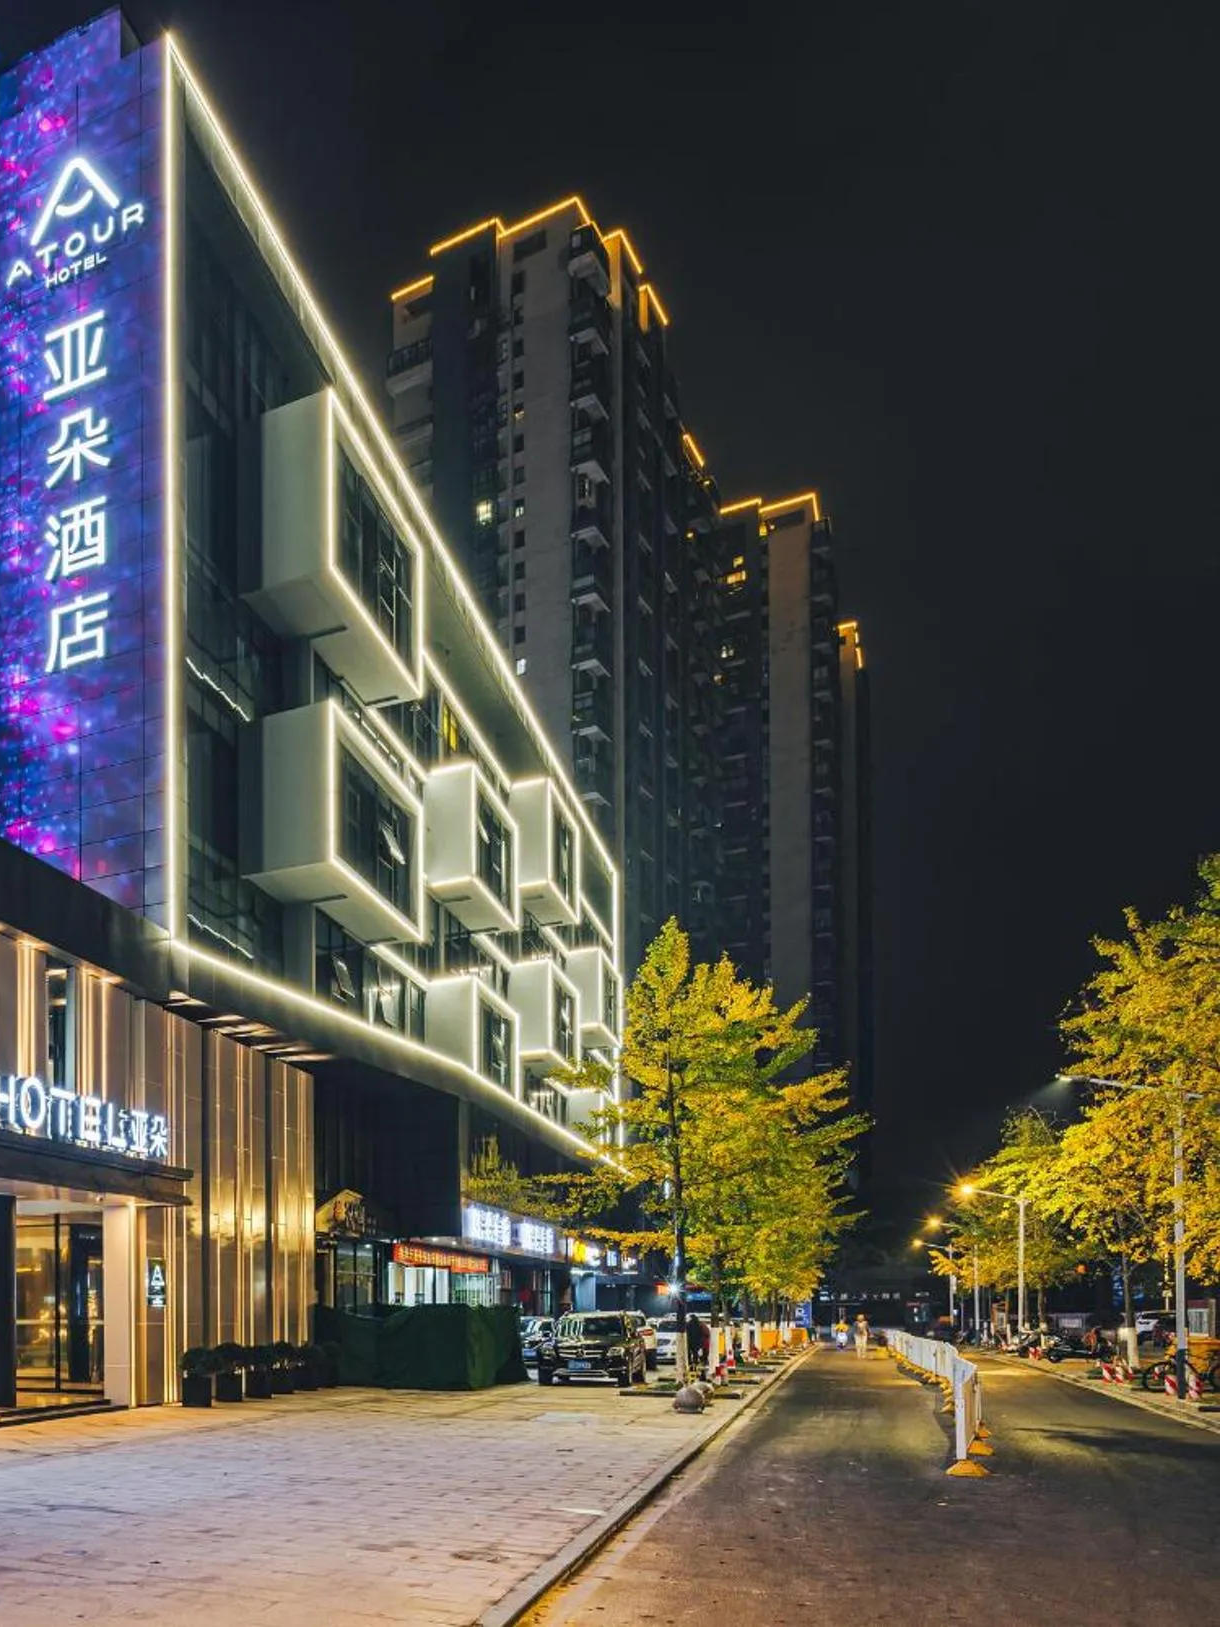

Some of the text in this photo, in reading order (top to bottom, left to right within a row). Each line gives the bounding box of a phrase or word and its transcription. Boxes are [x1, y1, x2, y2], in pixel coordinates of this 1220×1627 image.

[6, 202, 145, 288] ATOUR
[44, 251, 107, 289] HOTEL
[43, 309, 111, 674] 亚朵酒店
[129, 1108, 169, 1157] 亚朵
